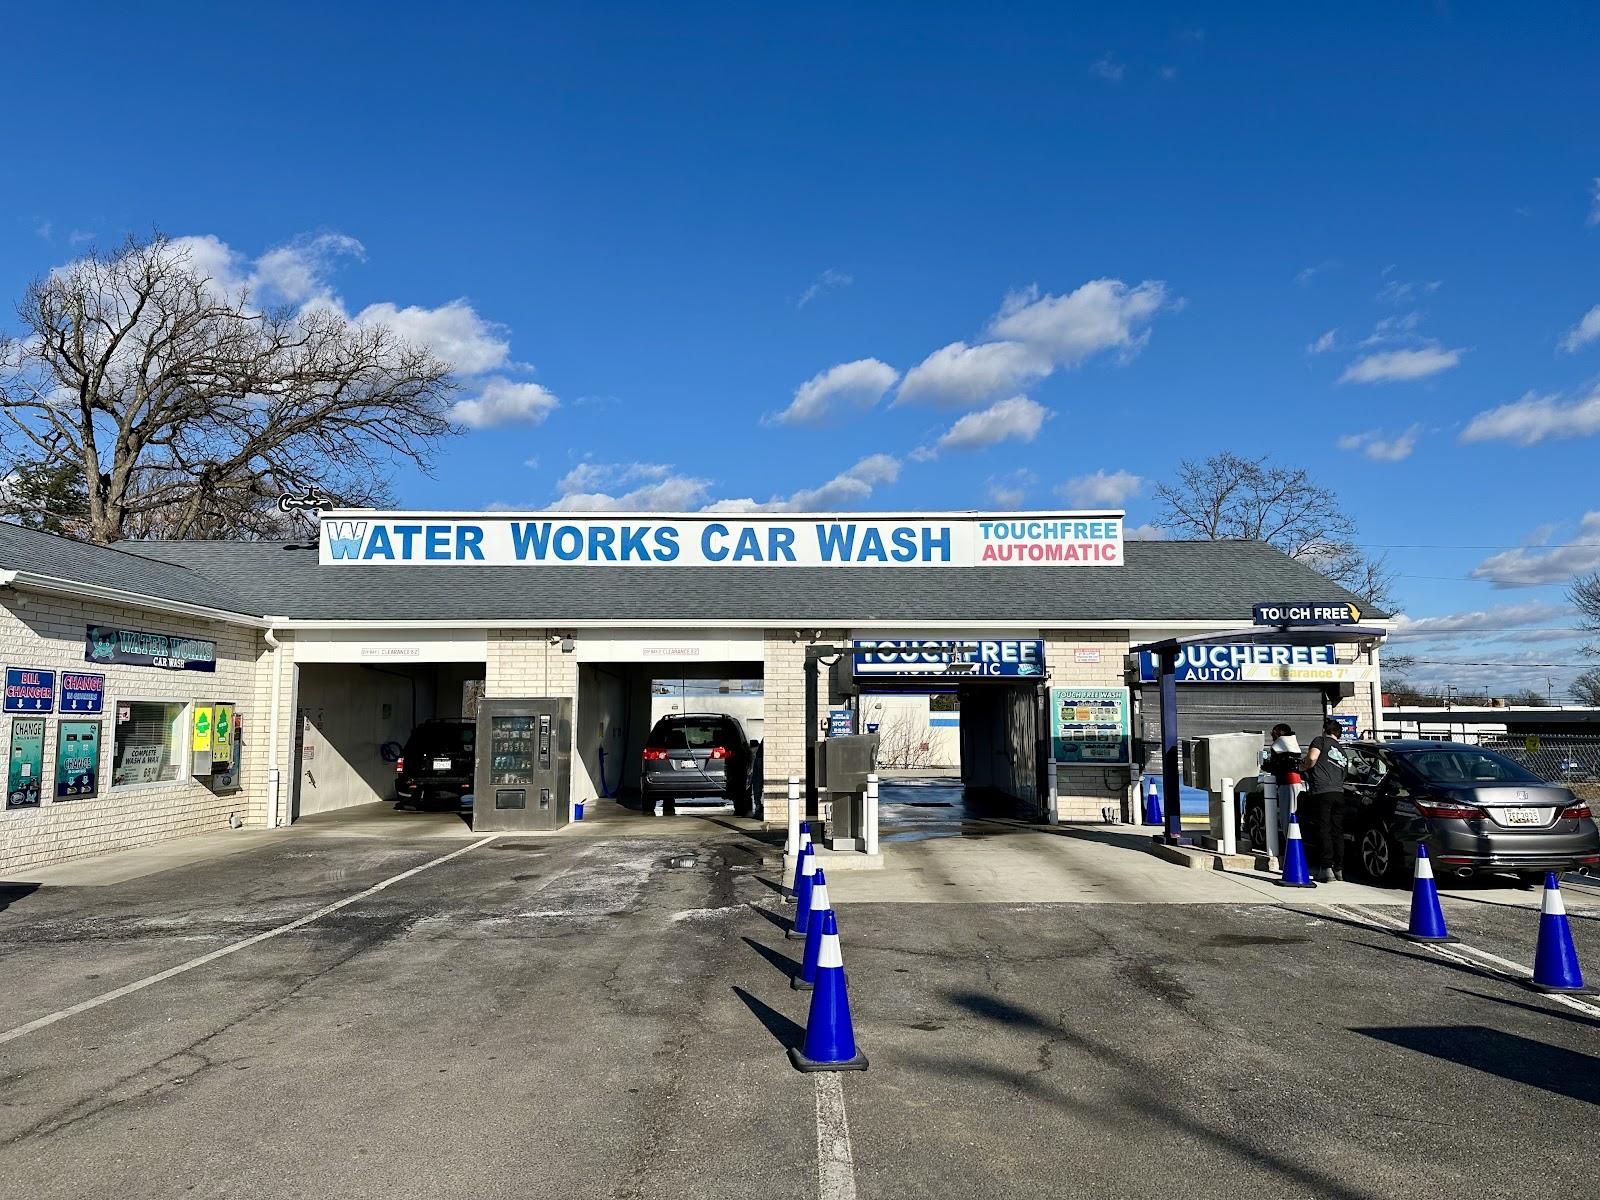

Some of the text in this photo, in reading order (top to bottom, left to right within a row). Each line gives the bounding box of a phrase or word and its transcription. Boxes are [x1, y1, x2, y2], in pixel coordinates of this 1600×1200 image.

[980, 522, 1118, 540] TOUCHFREE
[326, 521, 951, 562] WATER WORKS CAR WASH
[981, 543, 1117, 562] AUTOMATIC
[1260, 606, 1349, 621] TOUCH FREE
[119, 630, 213, 661] WATER WORKS
[153, 656, 185, 669] CAR WASH
[21, 672, 40, 685] BILL
[1270, 667, 1332, 678] Clearance
[63, 675, 103, 692] CHANGE
[7, 685, 52, 698] CHANGER
[1057, 690, 1081, 699] TOUCH
[1100, 690, 1122, 699] WASH
[15, 722, 42, 736] CHANGE
[131, 749, 157, 757] COMPLETE
[64, 757, 92, 770] CHANGE
[125, 758, 141, 766] WASH
[147, 756, 160, 764] WAX
